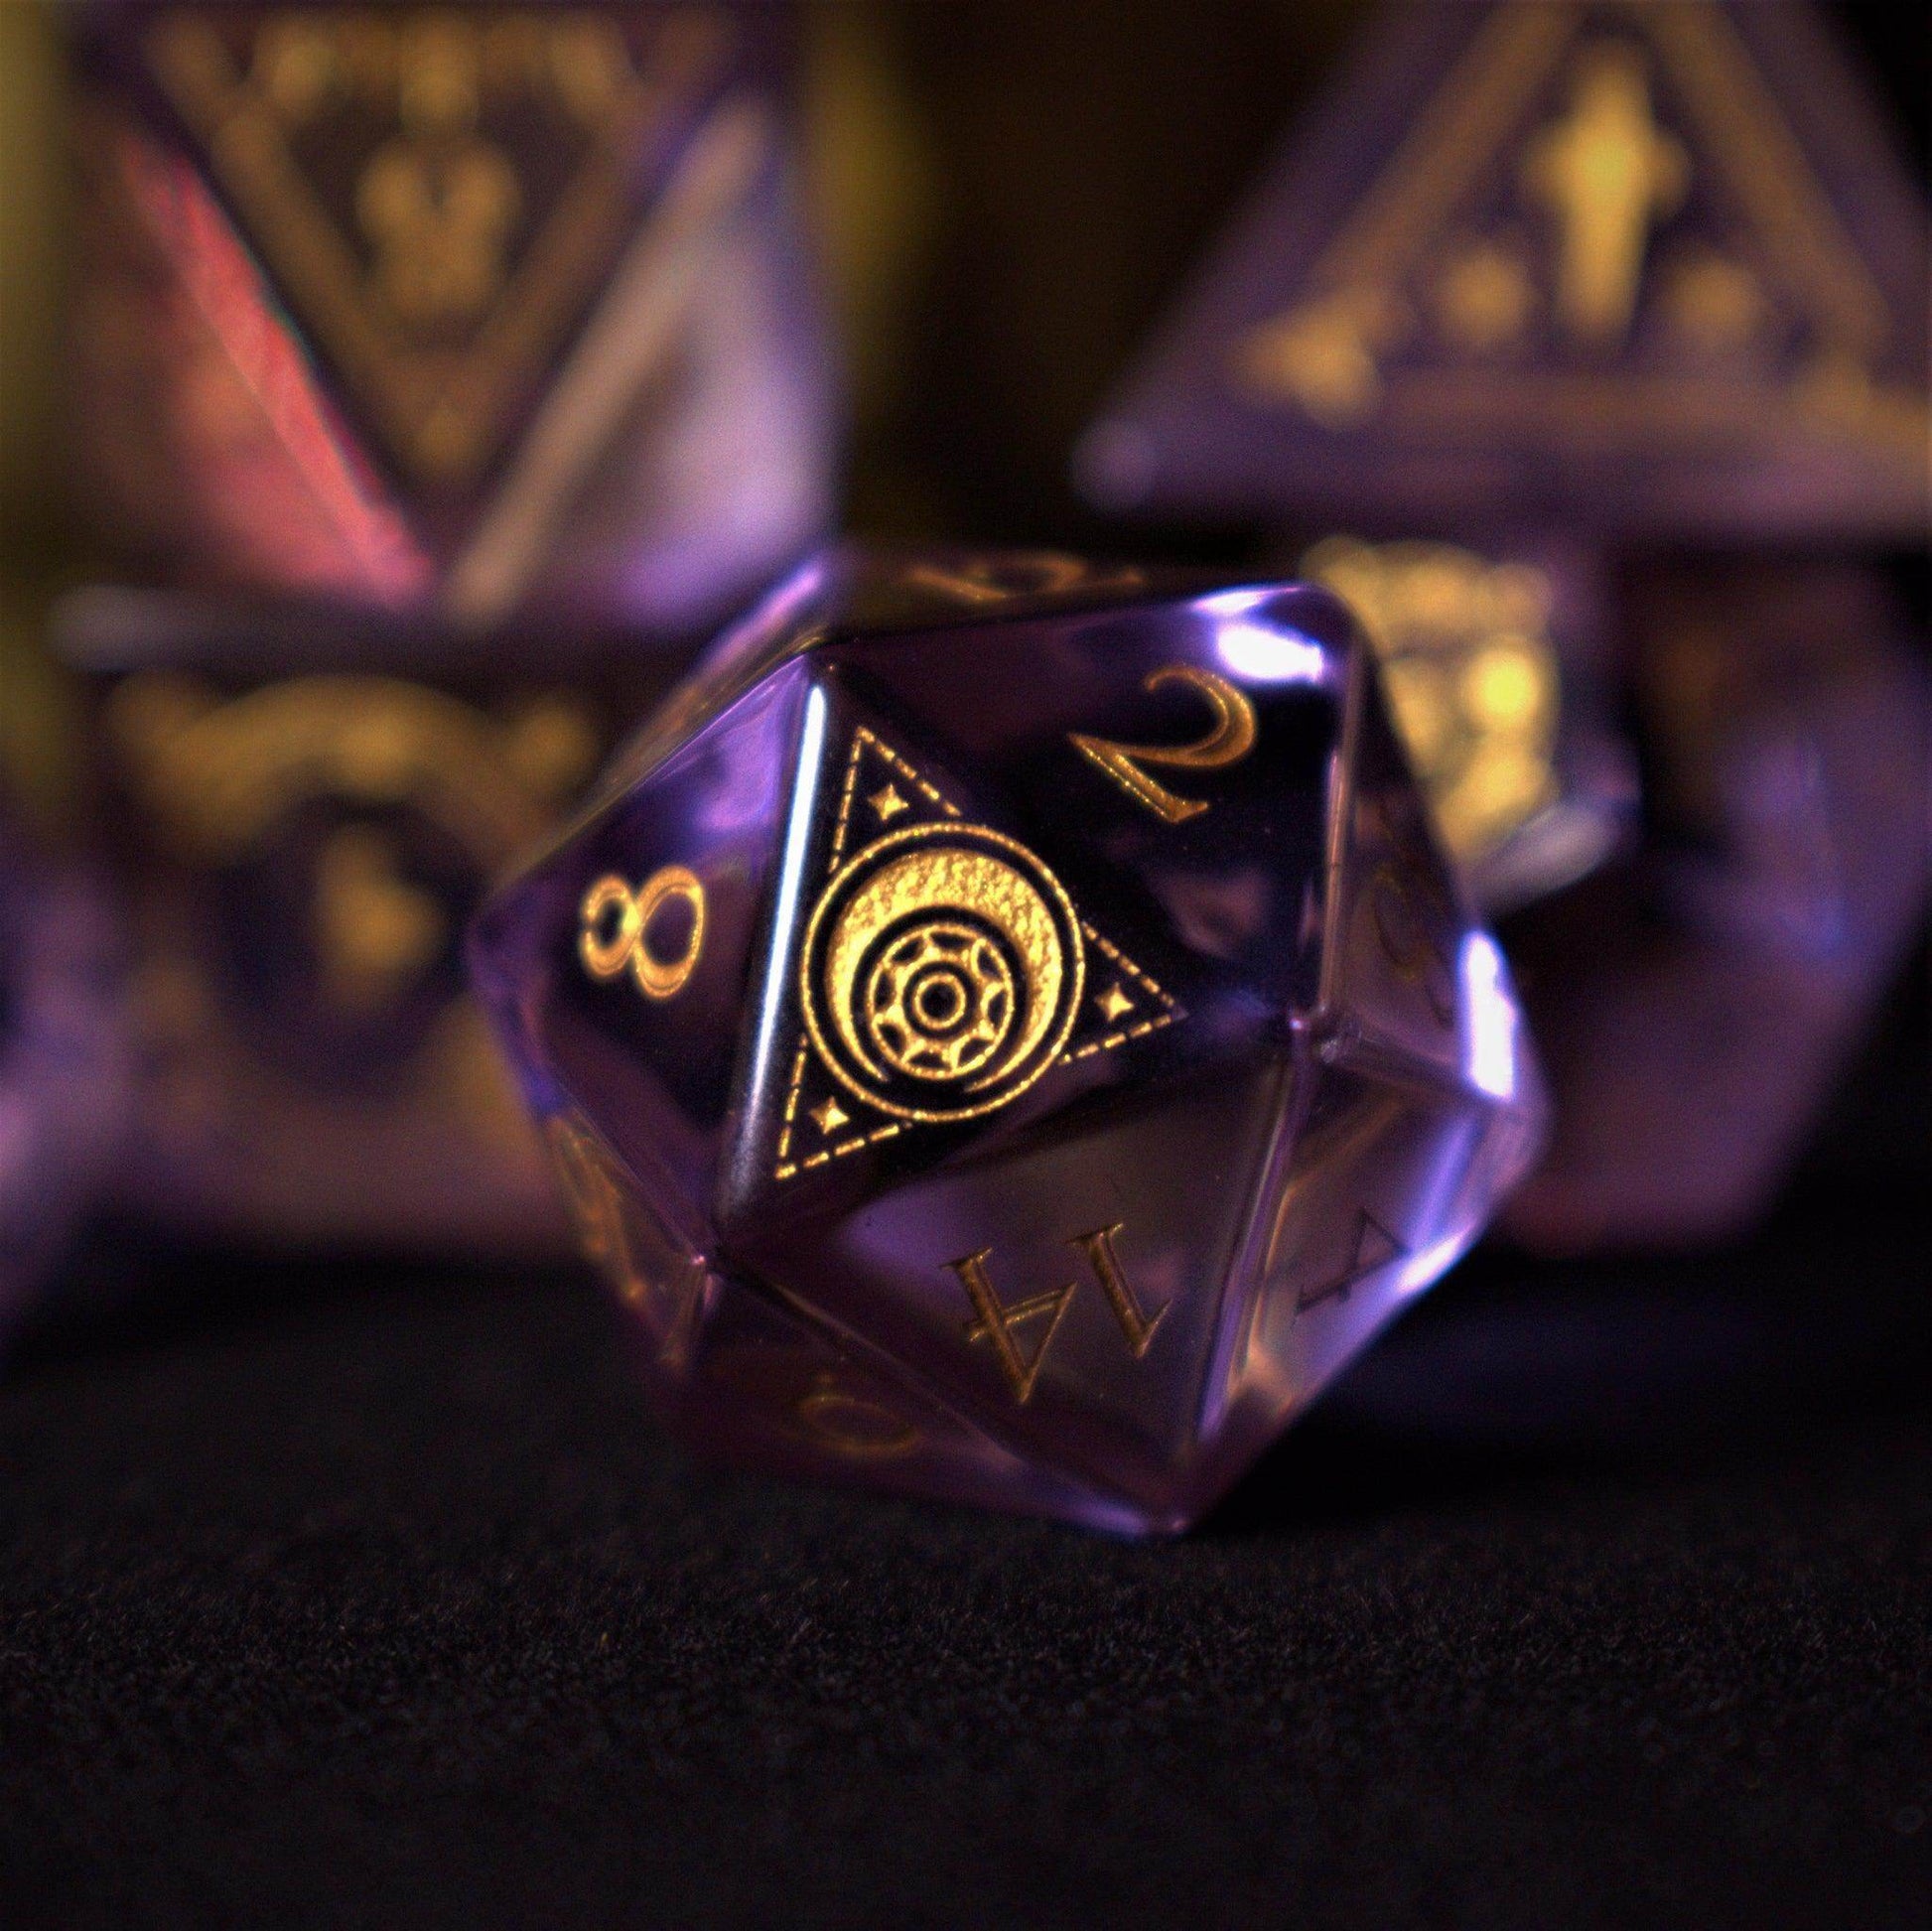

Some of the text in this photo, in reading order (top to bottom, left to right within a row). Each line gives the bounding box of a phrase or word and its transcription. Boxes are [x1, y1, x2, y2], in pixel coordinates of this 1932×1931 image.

[1066, 665, 1257, 825] 2
[579, 867, 706, 999] 8
[941, 1222, 1173, 1404] 14
